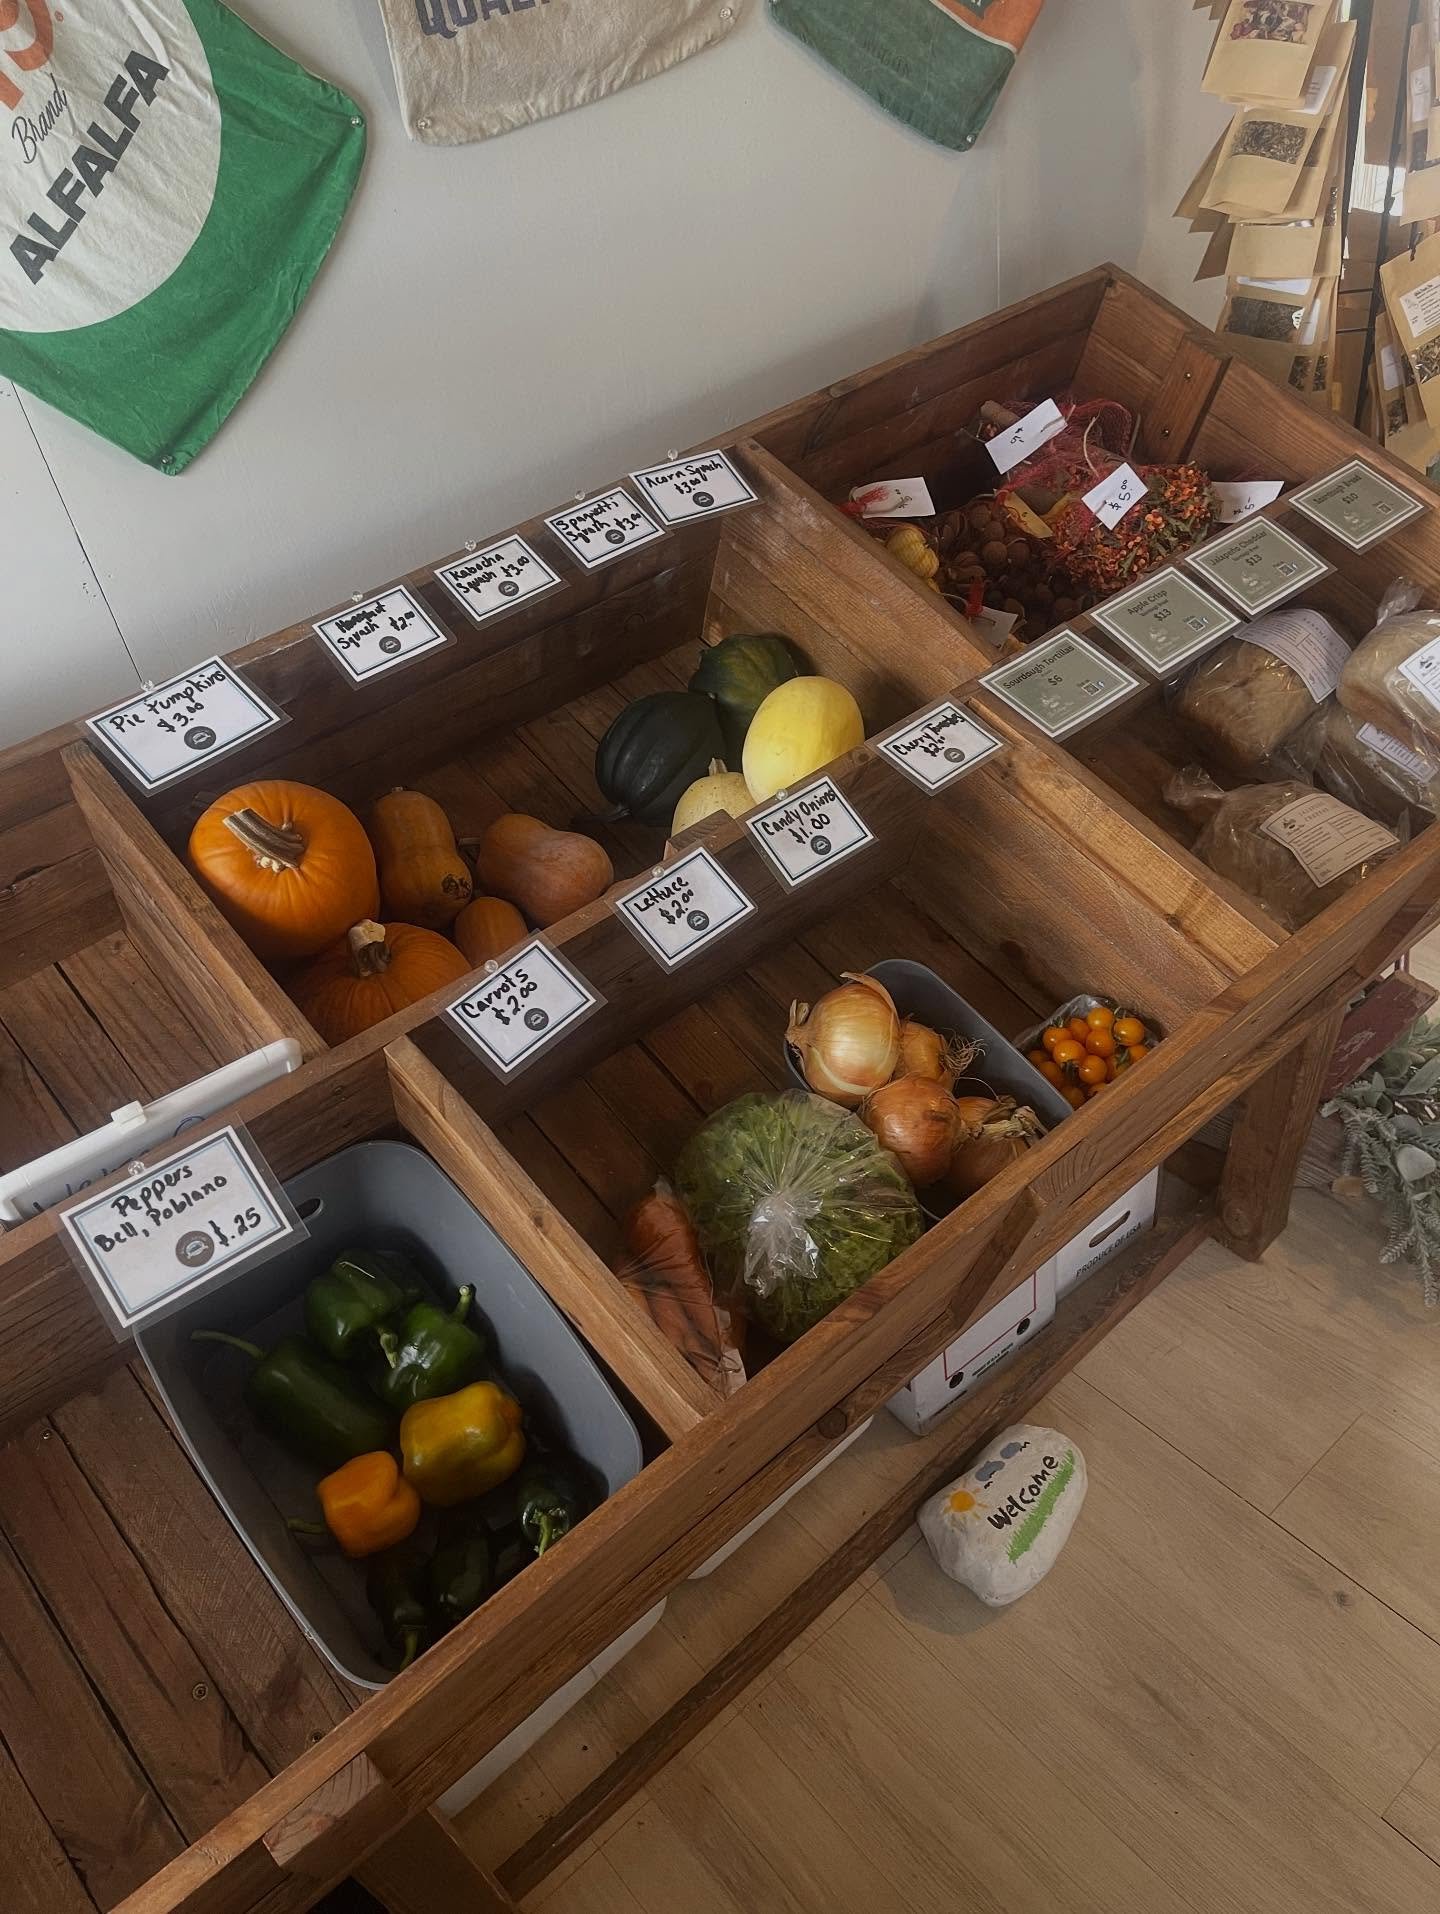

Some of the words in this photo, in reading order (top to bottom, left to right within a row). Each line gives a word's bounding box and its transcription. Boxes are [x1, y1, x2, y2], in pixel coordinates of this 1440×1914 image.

[12, 73, 68, 164] Brand
[10, 50, 170, 285] ALFALFA
[645, 470, 685, 488] Acorn
[685, 460, 723, 481] Squash
[448, 553, 505, 581] Kabocha
[1245, 554, 1263, 567] $13
[456, 571, 498, 593] Squash
[1127, 598, 1149, 615] Apple
[1147, 590, 1168, 603] Crisp
[1153, 608, 1172, 621] $13
[337, 621, 380, 650] Squash
[1002, 662, 1046, 689] Sourdough
[1043, 645, 1075, 666] Tortillas
[1047, 674, 1063, 687] $6
[109, 714, 145, 733] Pie
[144, 670, 226, 714] Pumpkins
[892, 732, 939, 755] Cherry
[761, 809, 804, 836] Candy
[798, 789, 836, 816] Onions
[788, 813, 831, 845] $1.00
[633, 876, 689, 912] Lettuce
[658, 889, 694, 925] $2.00
[460, 968, 529, 1019] Carrots
[491, 981, 538, 1026] $2.00
[111, 1165, 193, 1217] Peppers
[94, 1221, 150, 1253] Bell,
[145, 1175, 228, 1227] Poblano
[1076, 1243, 1114, 1280] PRODUCE
[986, 1455, 1059, 1529] Welcome
